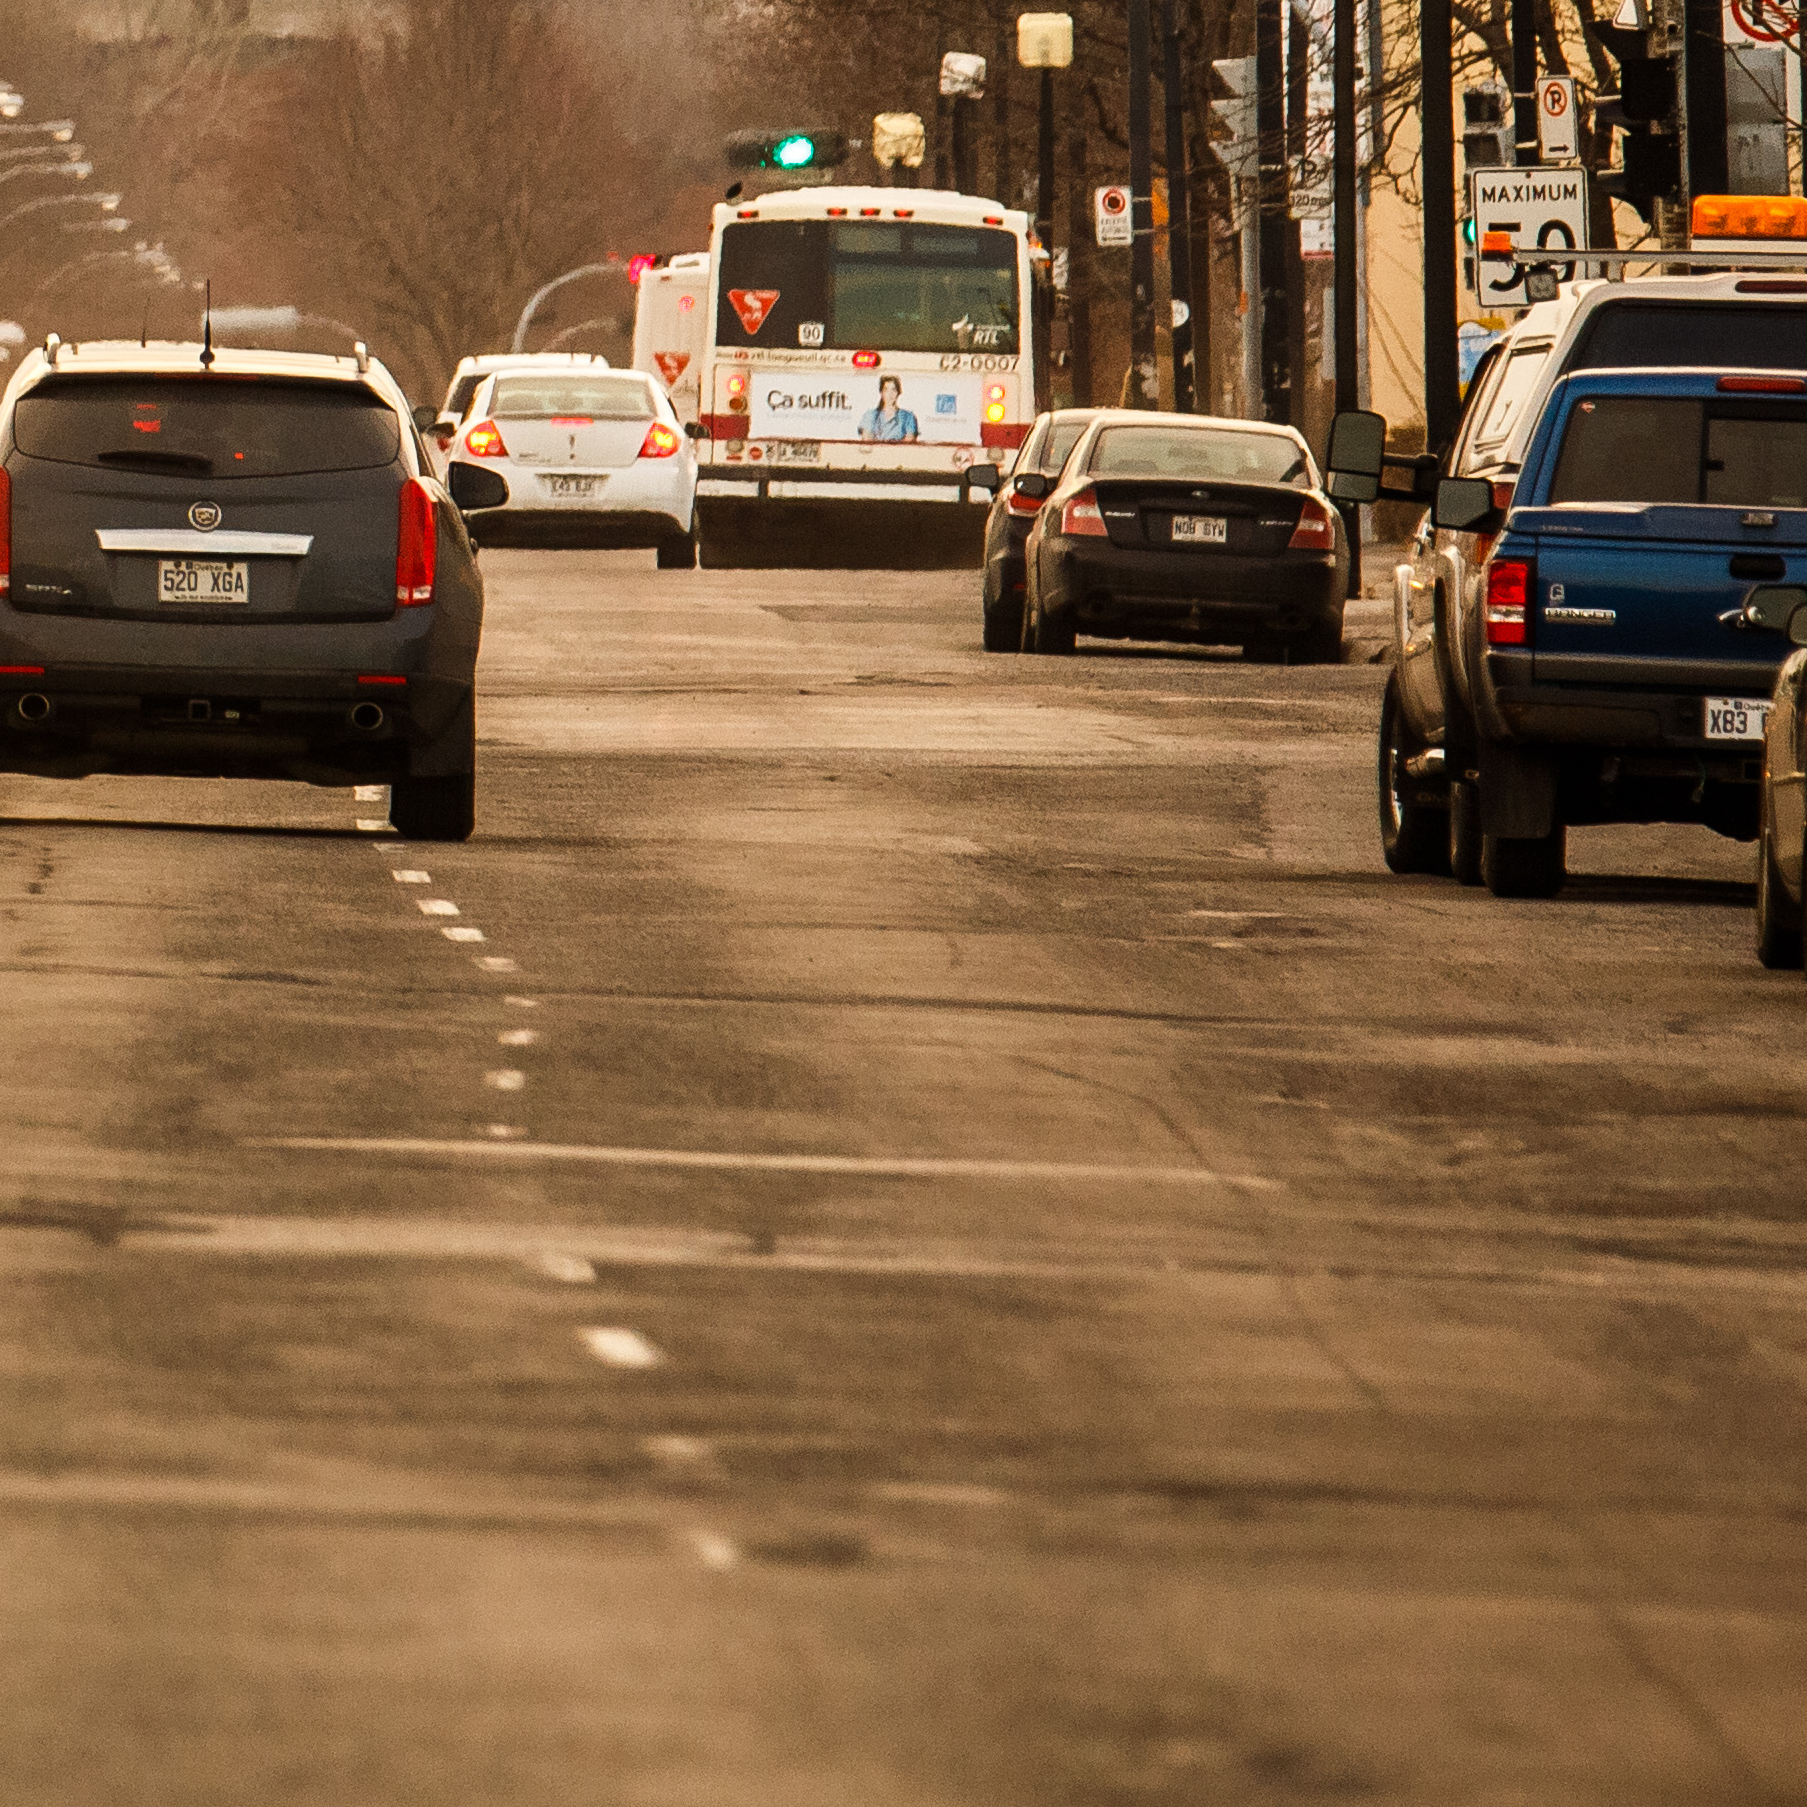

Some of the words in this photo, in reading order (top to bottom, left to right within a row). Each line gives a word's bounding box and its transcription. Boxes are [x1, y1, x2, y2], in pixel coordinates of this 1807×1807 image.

[1482, 183, 1578, 204] MAXIMUM
[1488, 219, 1577, 292] 50
[767, 389, 794, 411] Ça
[798, 390, 853, 410] suffit.
[163, 569, 198, 592] 520
[210, 571, 245, 593] XGA
[1709, 708, 1748, 735] X83
